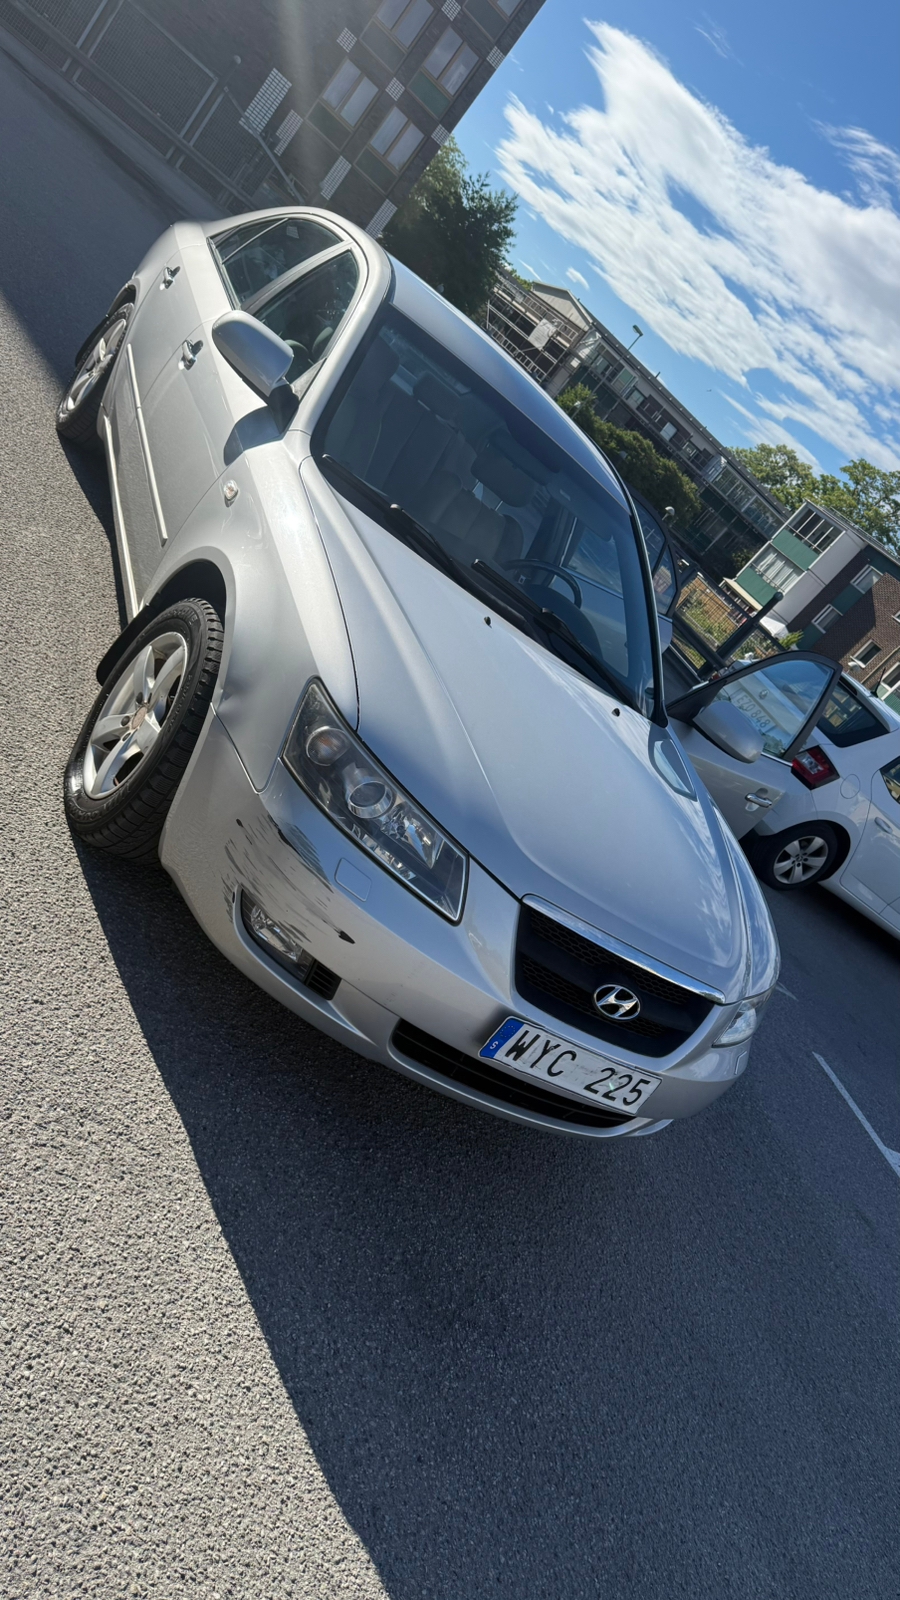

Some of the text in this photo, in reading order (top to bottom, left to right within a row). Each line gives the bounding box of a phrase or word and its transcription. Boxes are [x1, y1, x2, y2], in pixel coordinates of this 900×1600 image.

[751, 709, 771, 728] 848
[489, 1040, 499, 1050] S
[504, 1029, 652, 1106] WYC 225
